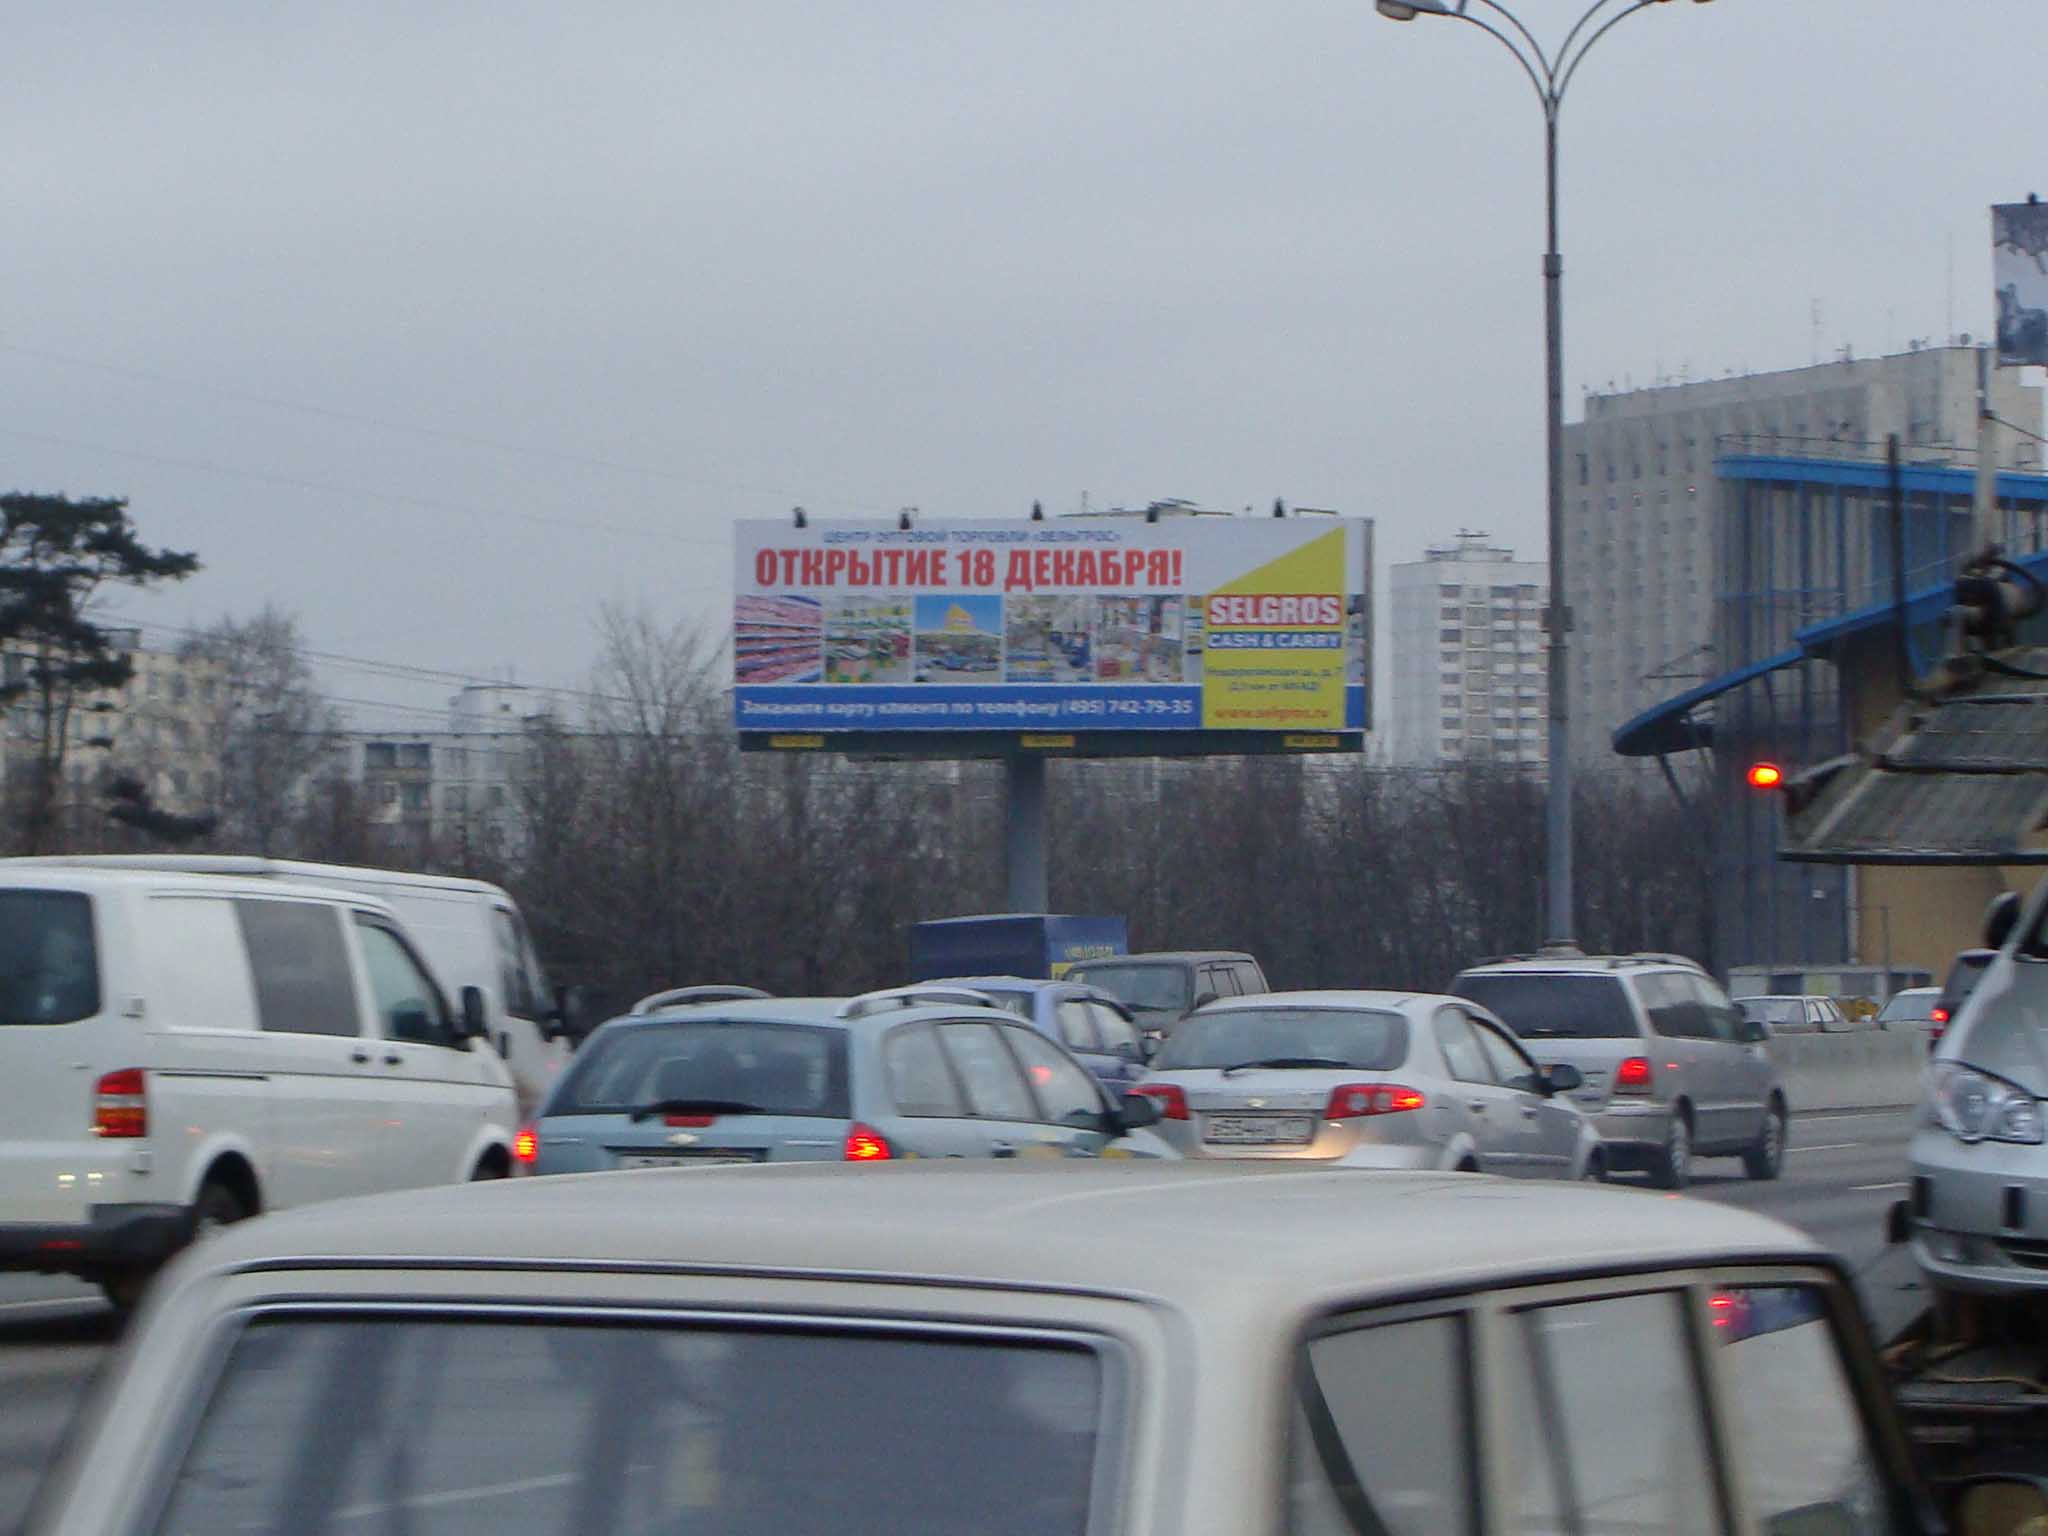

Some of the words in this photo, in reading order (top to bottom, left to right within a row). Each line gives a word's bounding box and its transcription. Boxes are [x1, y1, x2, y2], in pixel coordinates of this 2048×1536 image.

[756, 549, 947, 586] ОТКРЫТИЕ
[956, 549, 995, 586] 18
[1004, 549, 1182, 592] ДЕКАБРЯ!
[1210, 596, 1339, 624] SELGROS
[1209, 634, 1259, 648] CASH
[1276, 634, 1338, 648] CARRY
